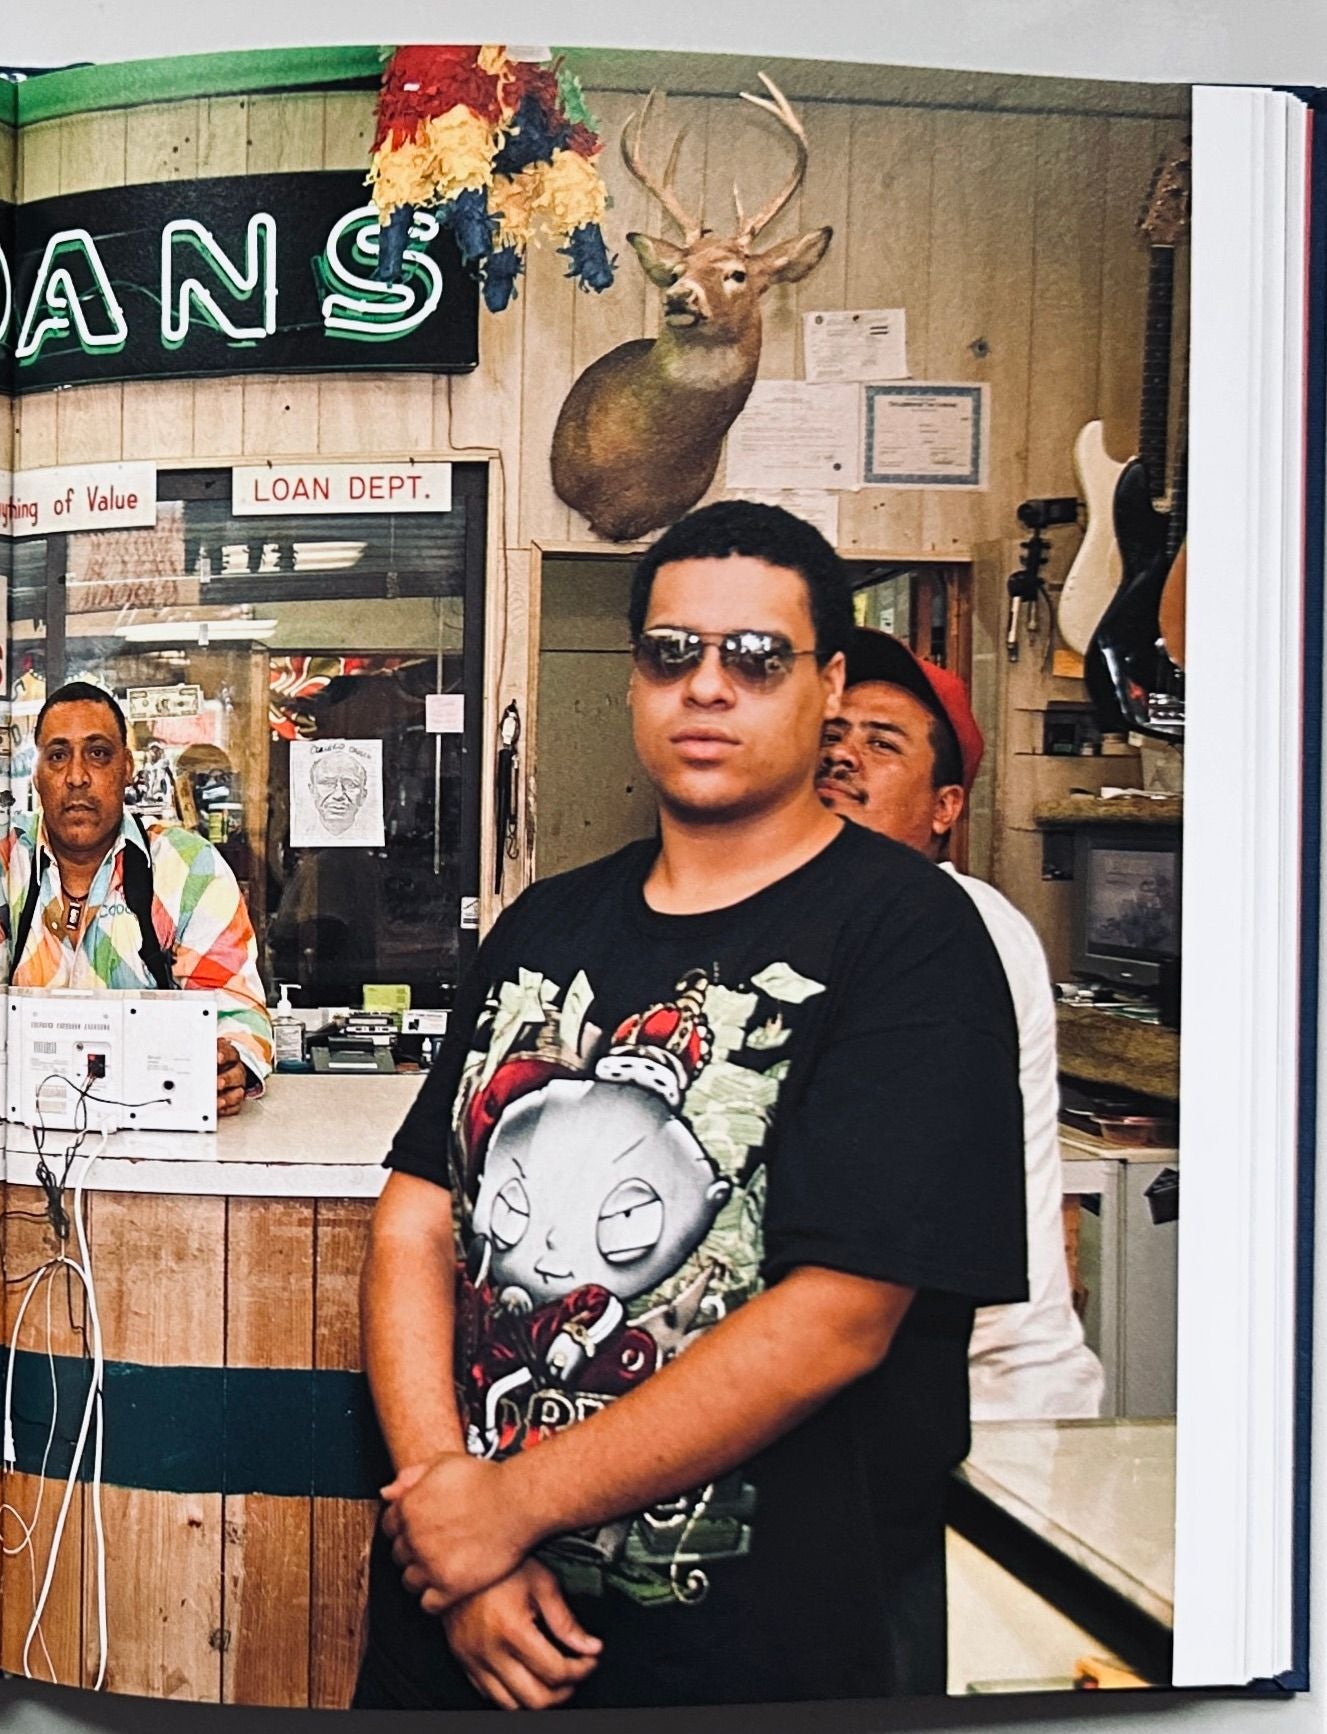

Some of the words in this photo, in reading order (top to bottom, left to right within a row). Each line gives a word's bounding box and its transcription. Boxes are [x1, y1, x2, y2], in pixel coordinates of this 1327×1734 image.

[53, 487, 75, 516] of
[87, 484, 139, 512] Value
[253, 477, 330, 502] LOAN
[349, 475, 431, 500] DEPT.
